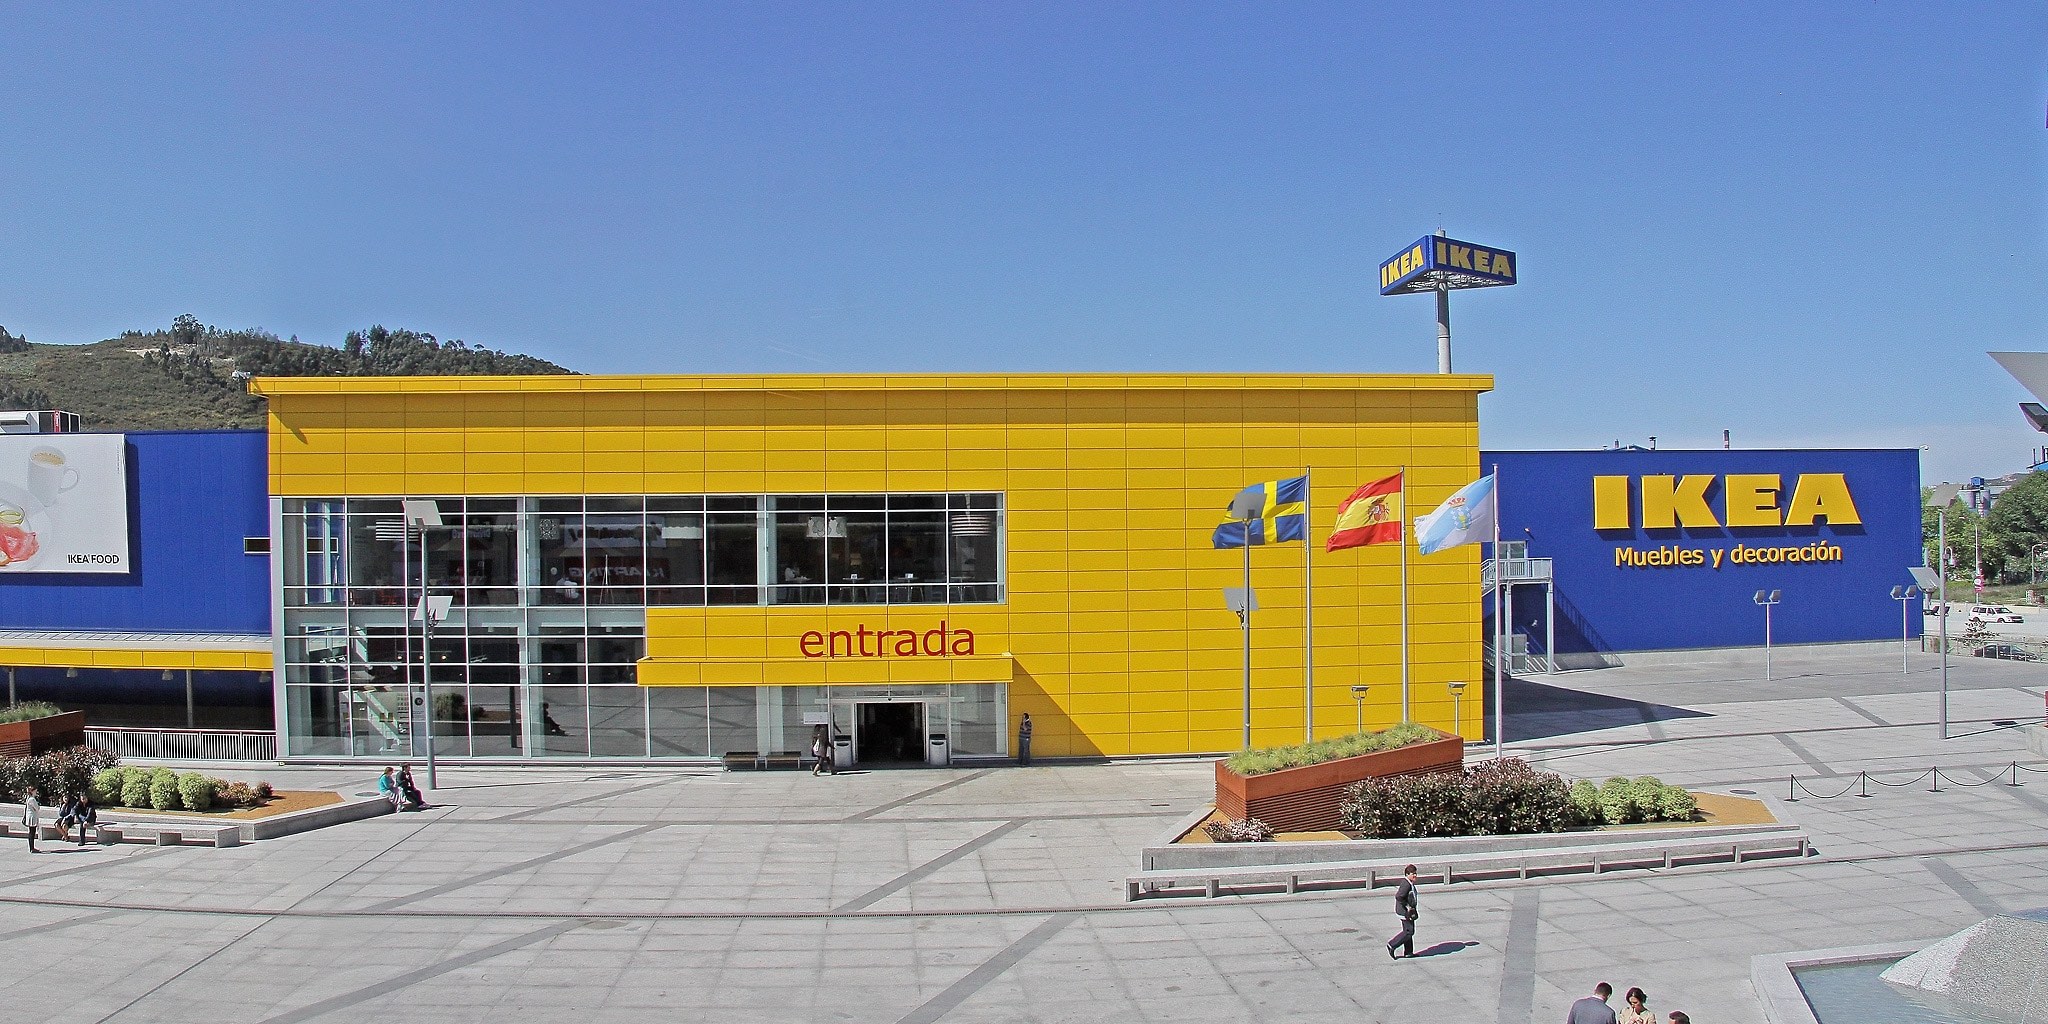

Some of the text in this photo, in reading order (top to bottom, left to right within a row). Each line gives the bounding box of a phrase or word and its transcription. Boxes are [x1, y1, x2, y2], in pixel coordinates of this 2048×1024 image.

[1381, 245, 1423, 288] IKEA
[1436, 242, 1512, 277] IKEA
[1593, 473, 1862, 530] IKEA
[68, 554, 119, 564] IKEA FOOD
[1615, 541, 1842, 569] Muebles y decoración
[799, 620, 976, 658] entrada
